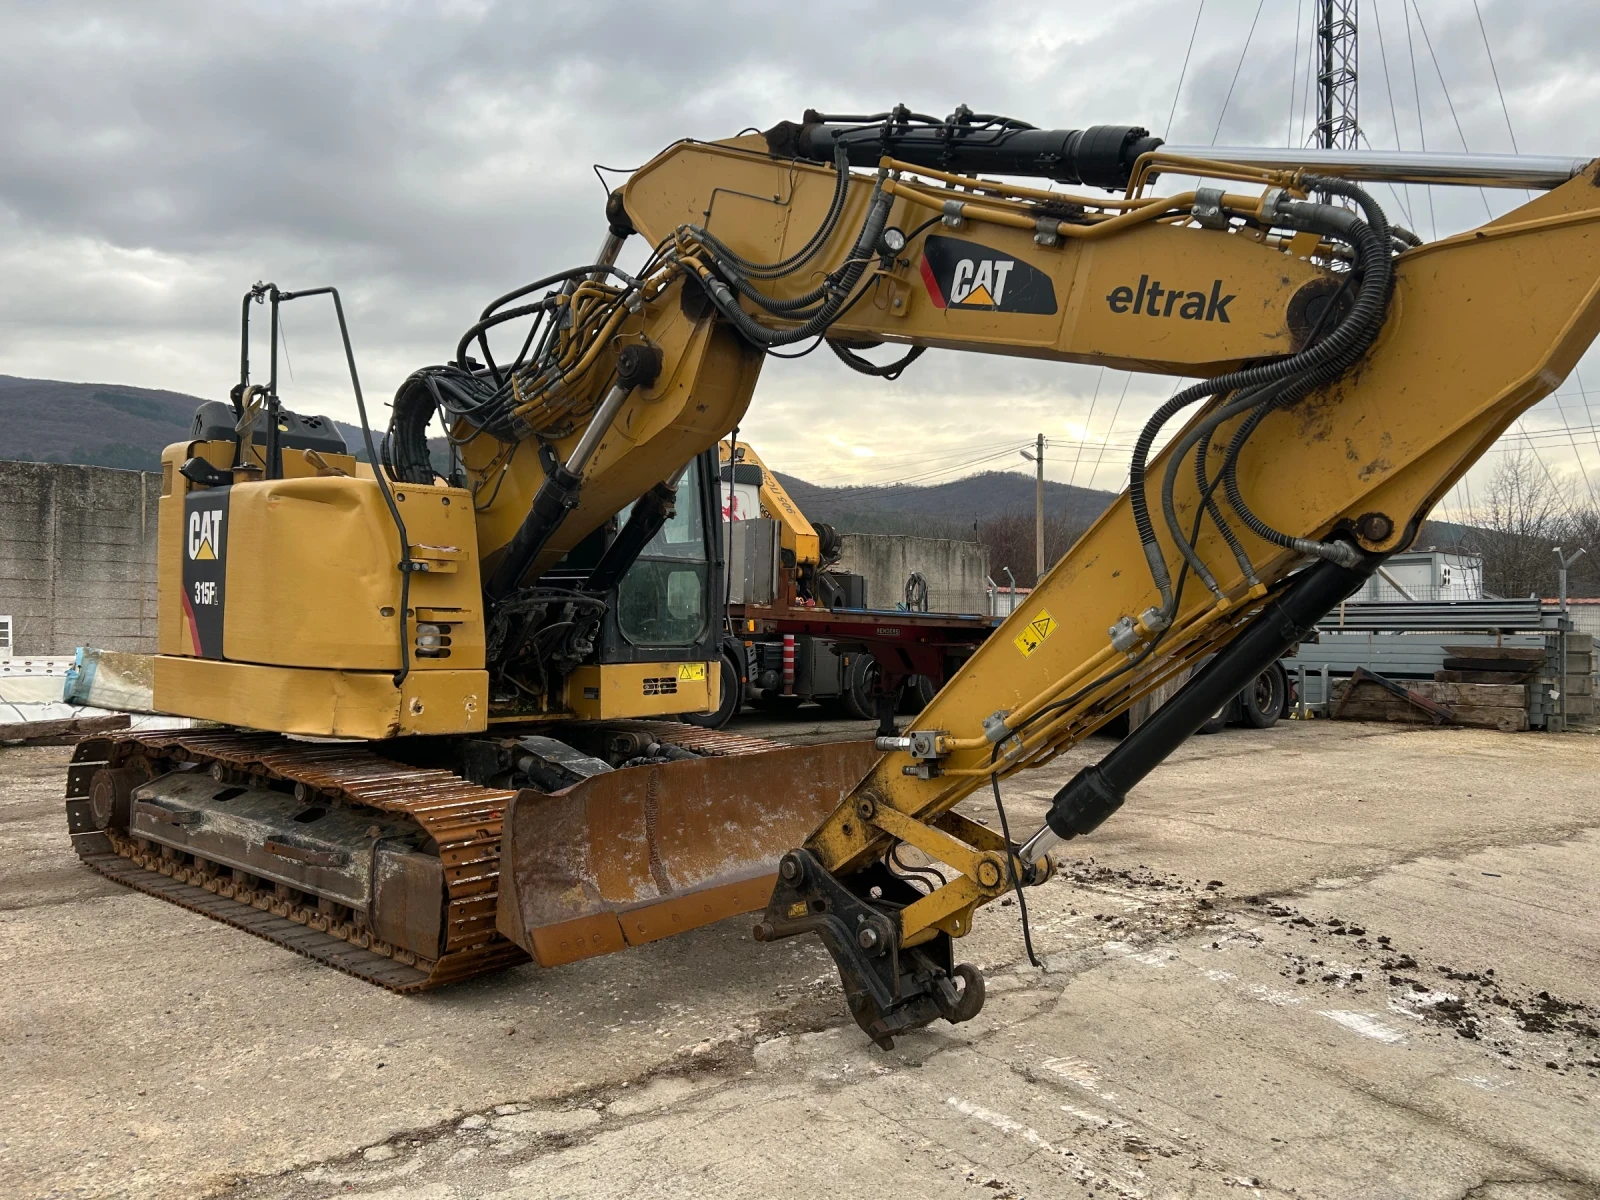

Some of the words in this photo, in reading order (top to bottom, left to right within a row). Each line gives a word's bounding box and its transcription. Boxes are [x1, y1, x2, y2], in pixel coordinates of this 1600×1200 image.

[950, 258, 1014, 306] CAT
[1105, 274, 1237, 323] eltrak
[188, 510, 223, 560] CAT
